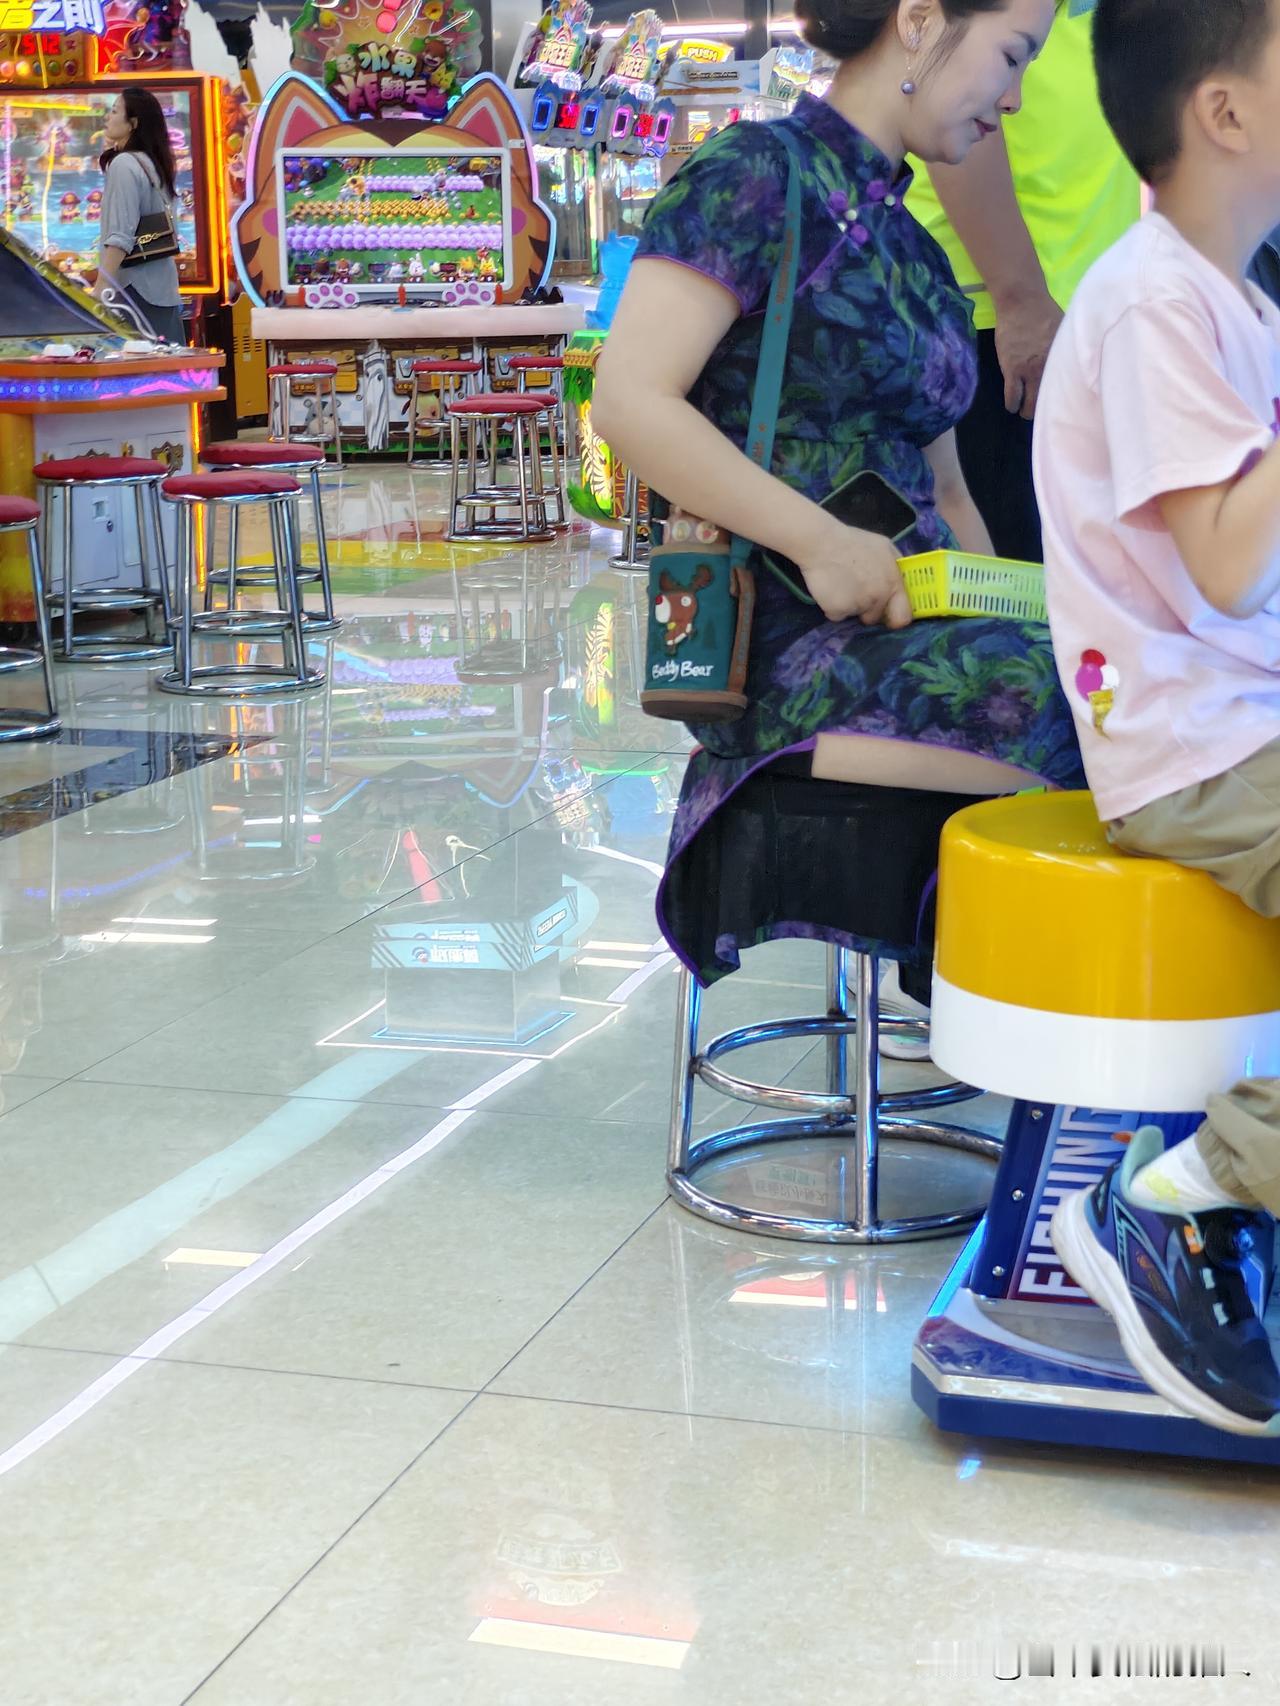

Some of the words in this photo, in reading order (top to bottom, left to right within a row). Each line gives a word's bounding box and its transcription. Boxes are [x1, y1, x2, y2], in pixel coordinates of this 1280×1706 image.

[358, 42, 417, 79] 水果
[680, 660, 714, 677] Bear
[1018, 1103, 1128, 1298] FIING
